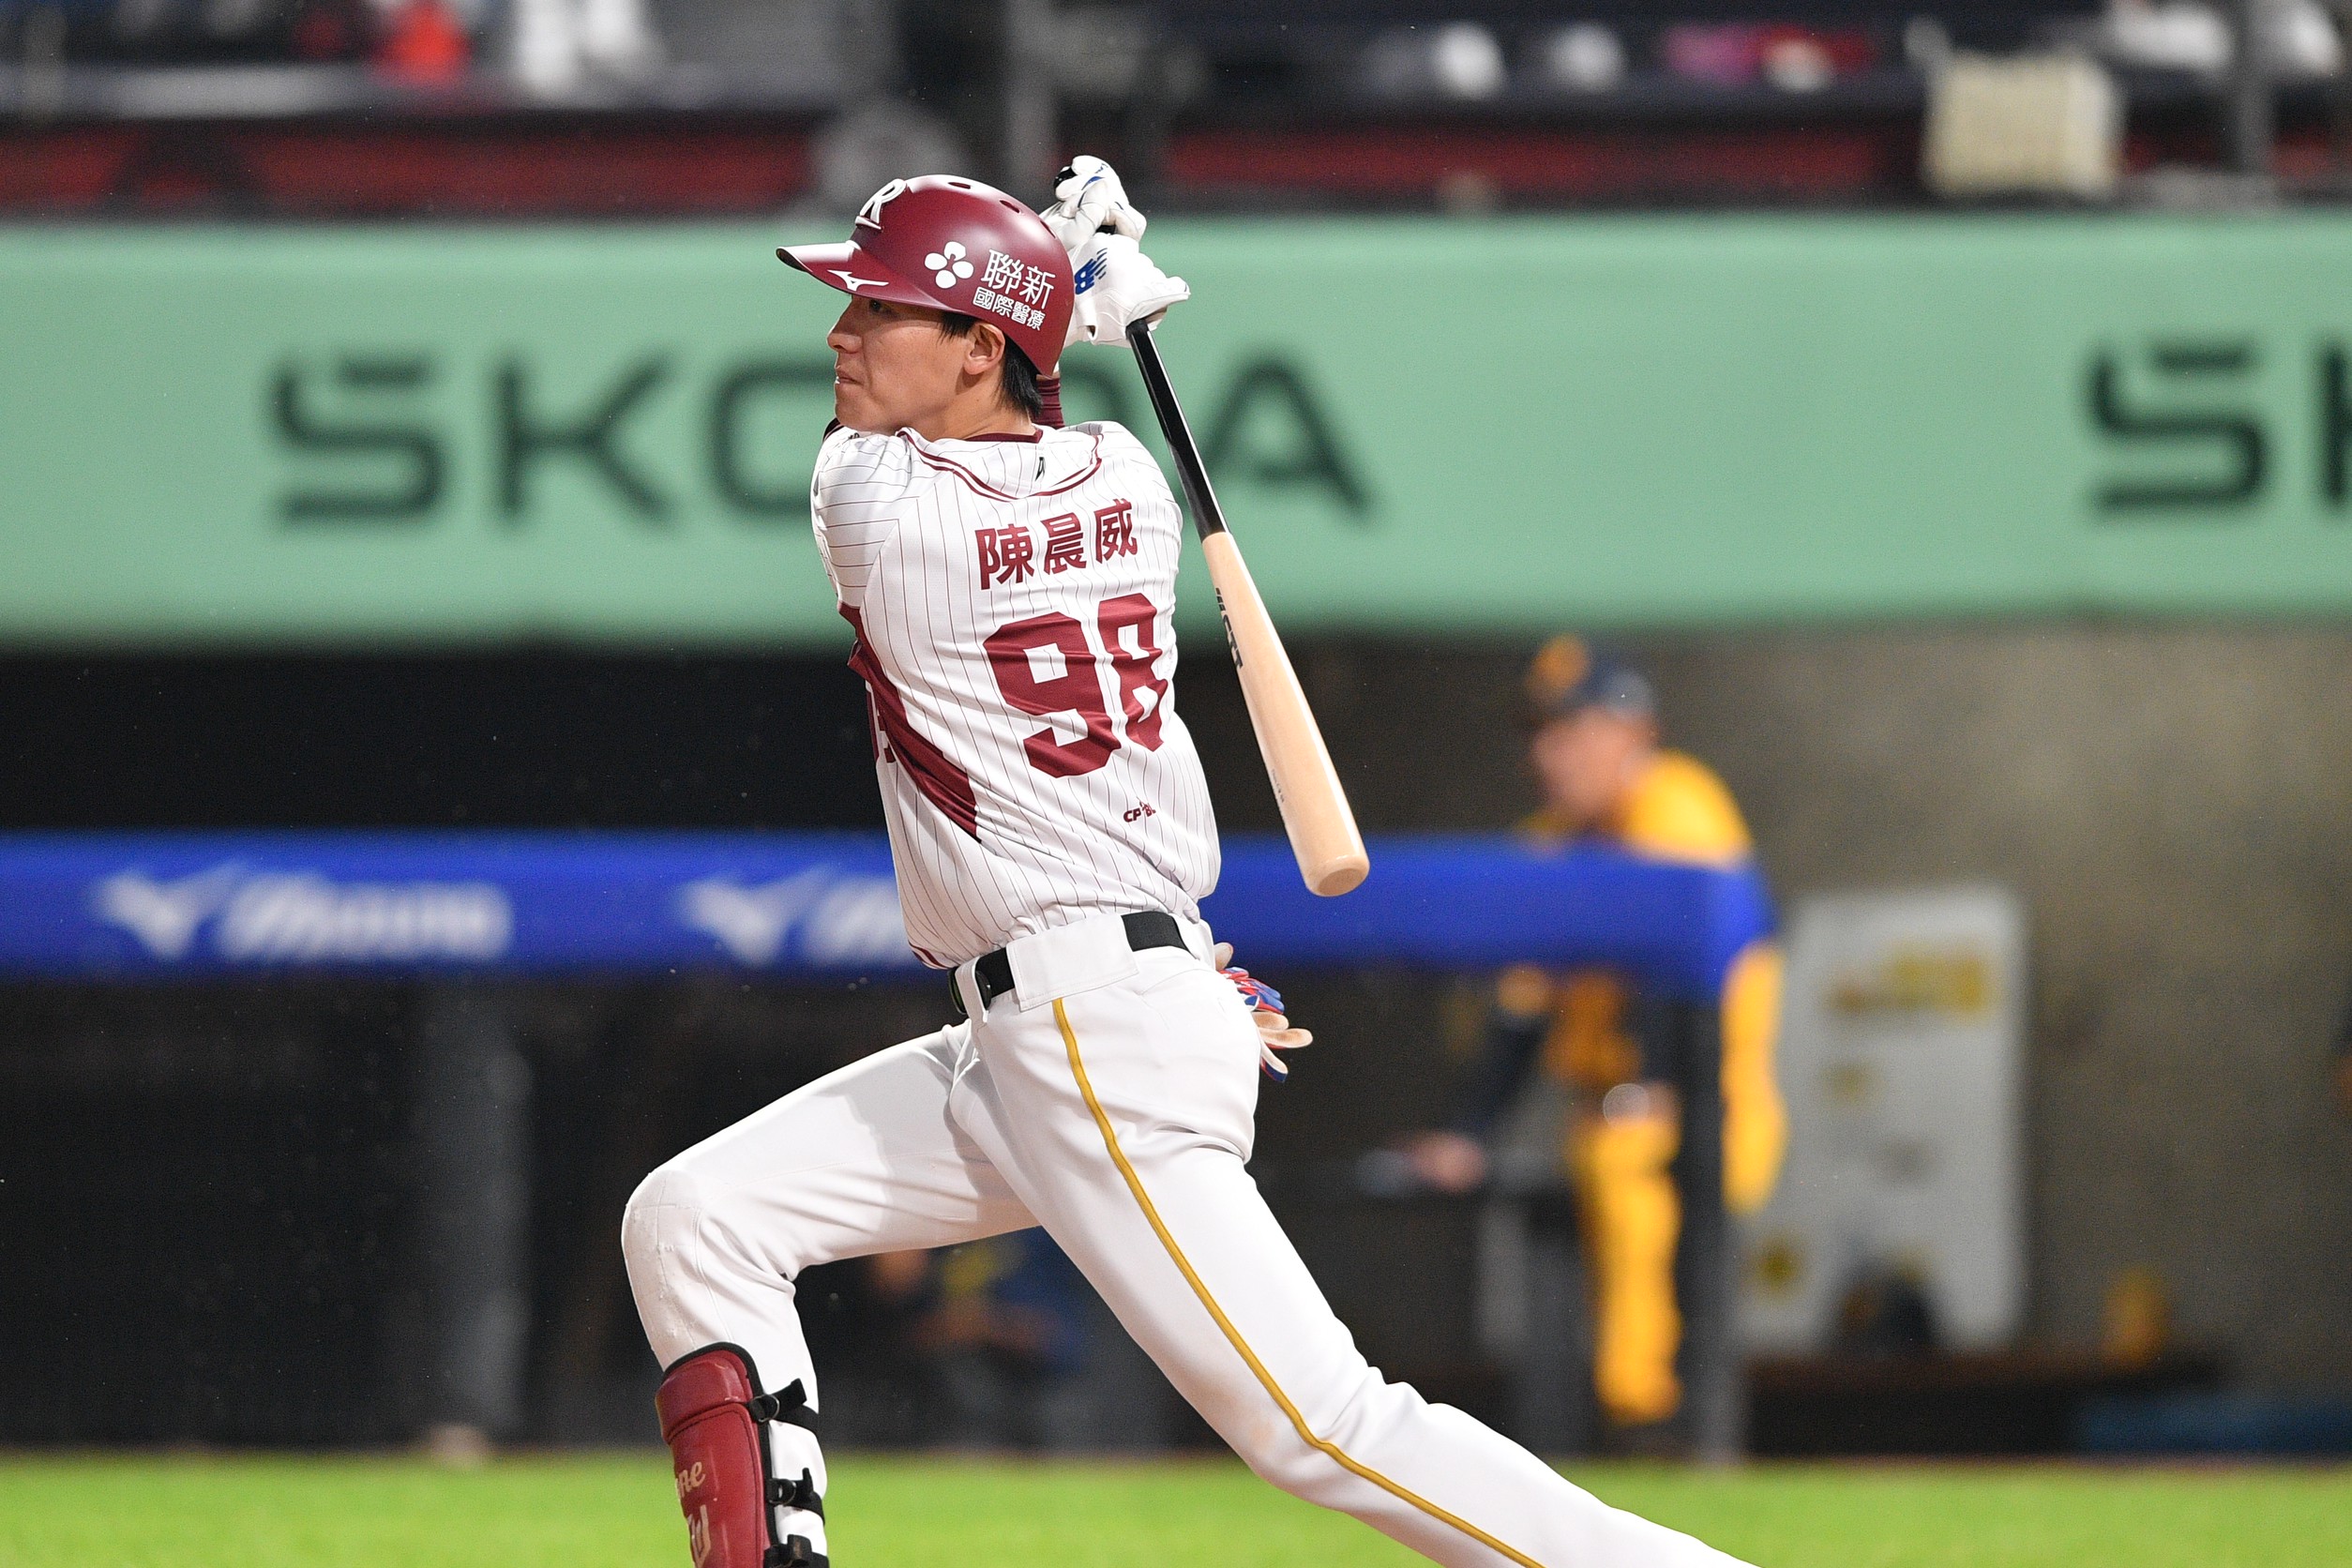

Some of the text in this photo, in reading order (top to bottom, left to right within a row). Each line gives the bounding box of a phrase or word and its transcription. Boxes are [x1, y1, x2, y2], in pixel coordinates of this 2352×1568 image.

[972, 286, 1046, 331] 國際醫療
[980, 249, 1056, 309] 聯新
[975, 498, 1138, 590] 陳晨威
[983, 593, 1168, 778] 98
